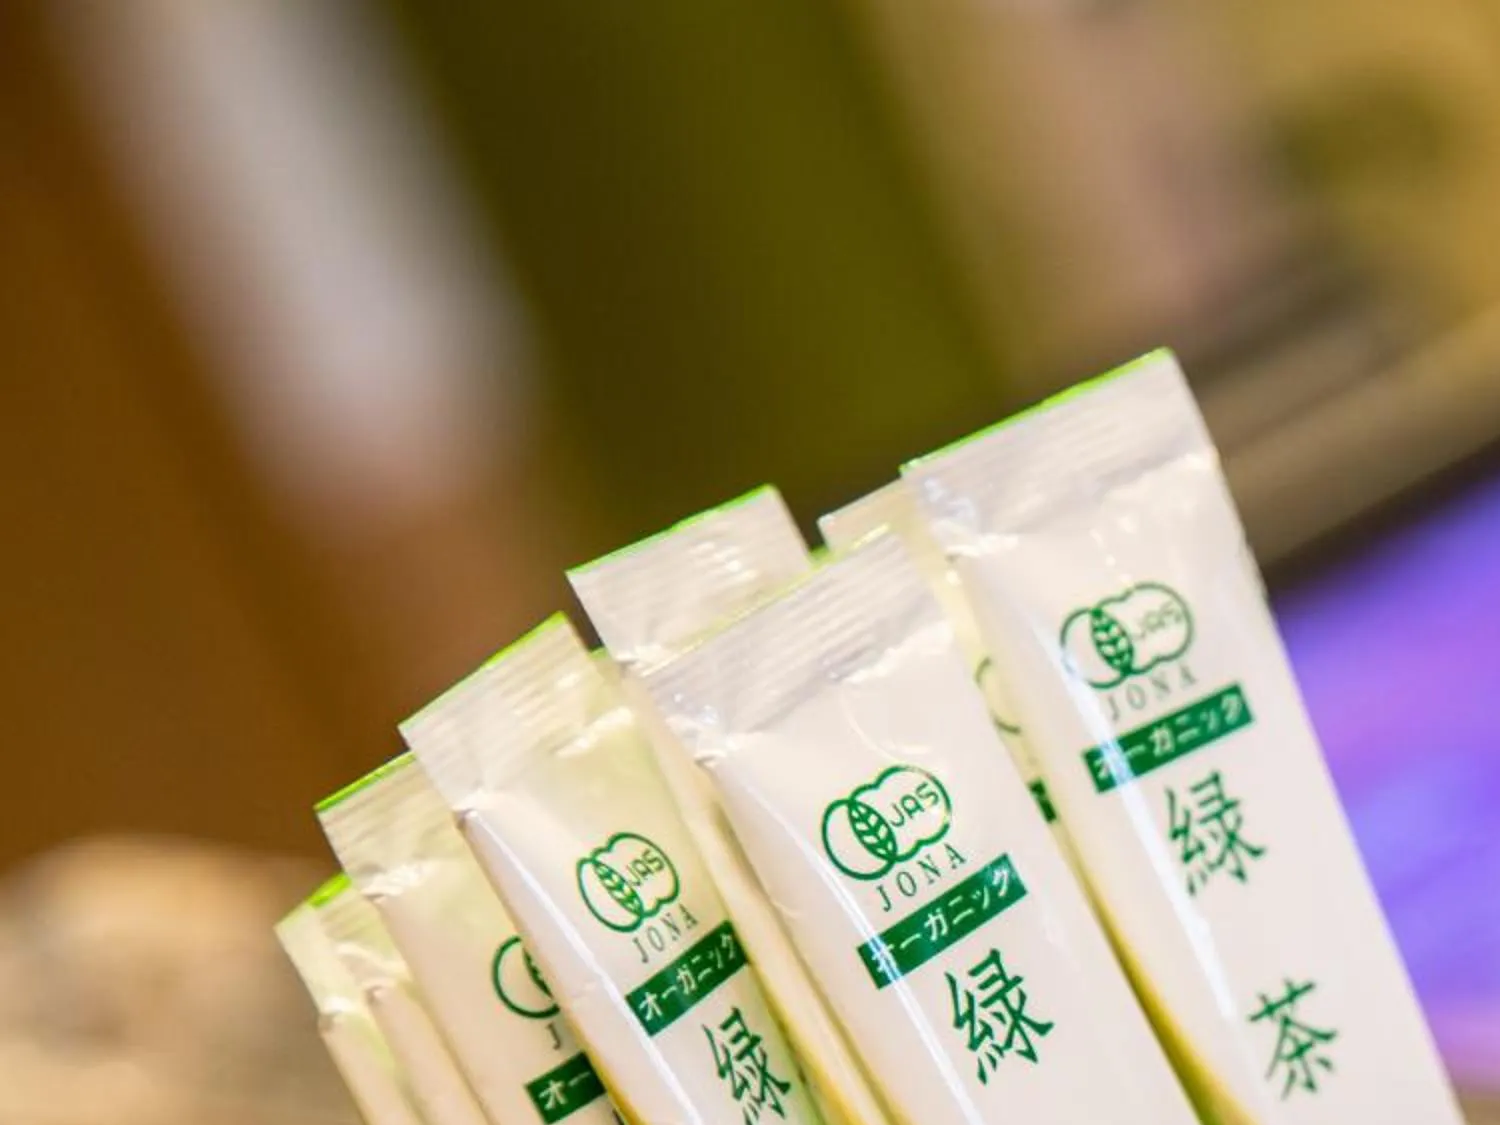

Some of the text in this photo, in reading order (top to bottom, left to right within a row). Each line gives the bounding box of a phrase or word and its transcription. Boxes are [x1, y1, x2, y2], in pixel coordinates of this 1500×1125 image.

[1108, 664, 1197, 722] JONA
[890, 781, 950, 829] JAS
[625, 849, 666, 888] JAS
[876, 842, 968, 913] JONA
[632, 903, 699, 965] JONA
[638, 932, 737, 1022] オーガニック
